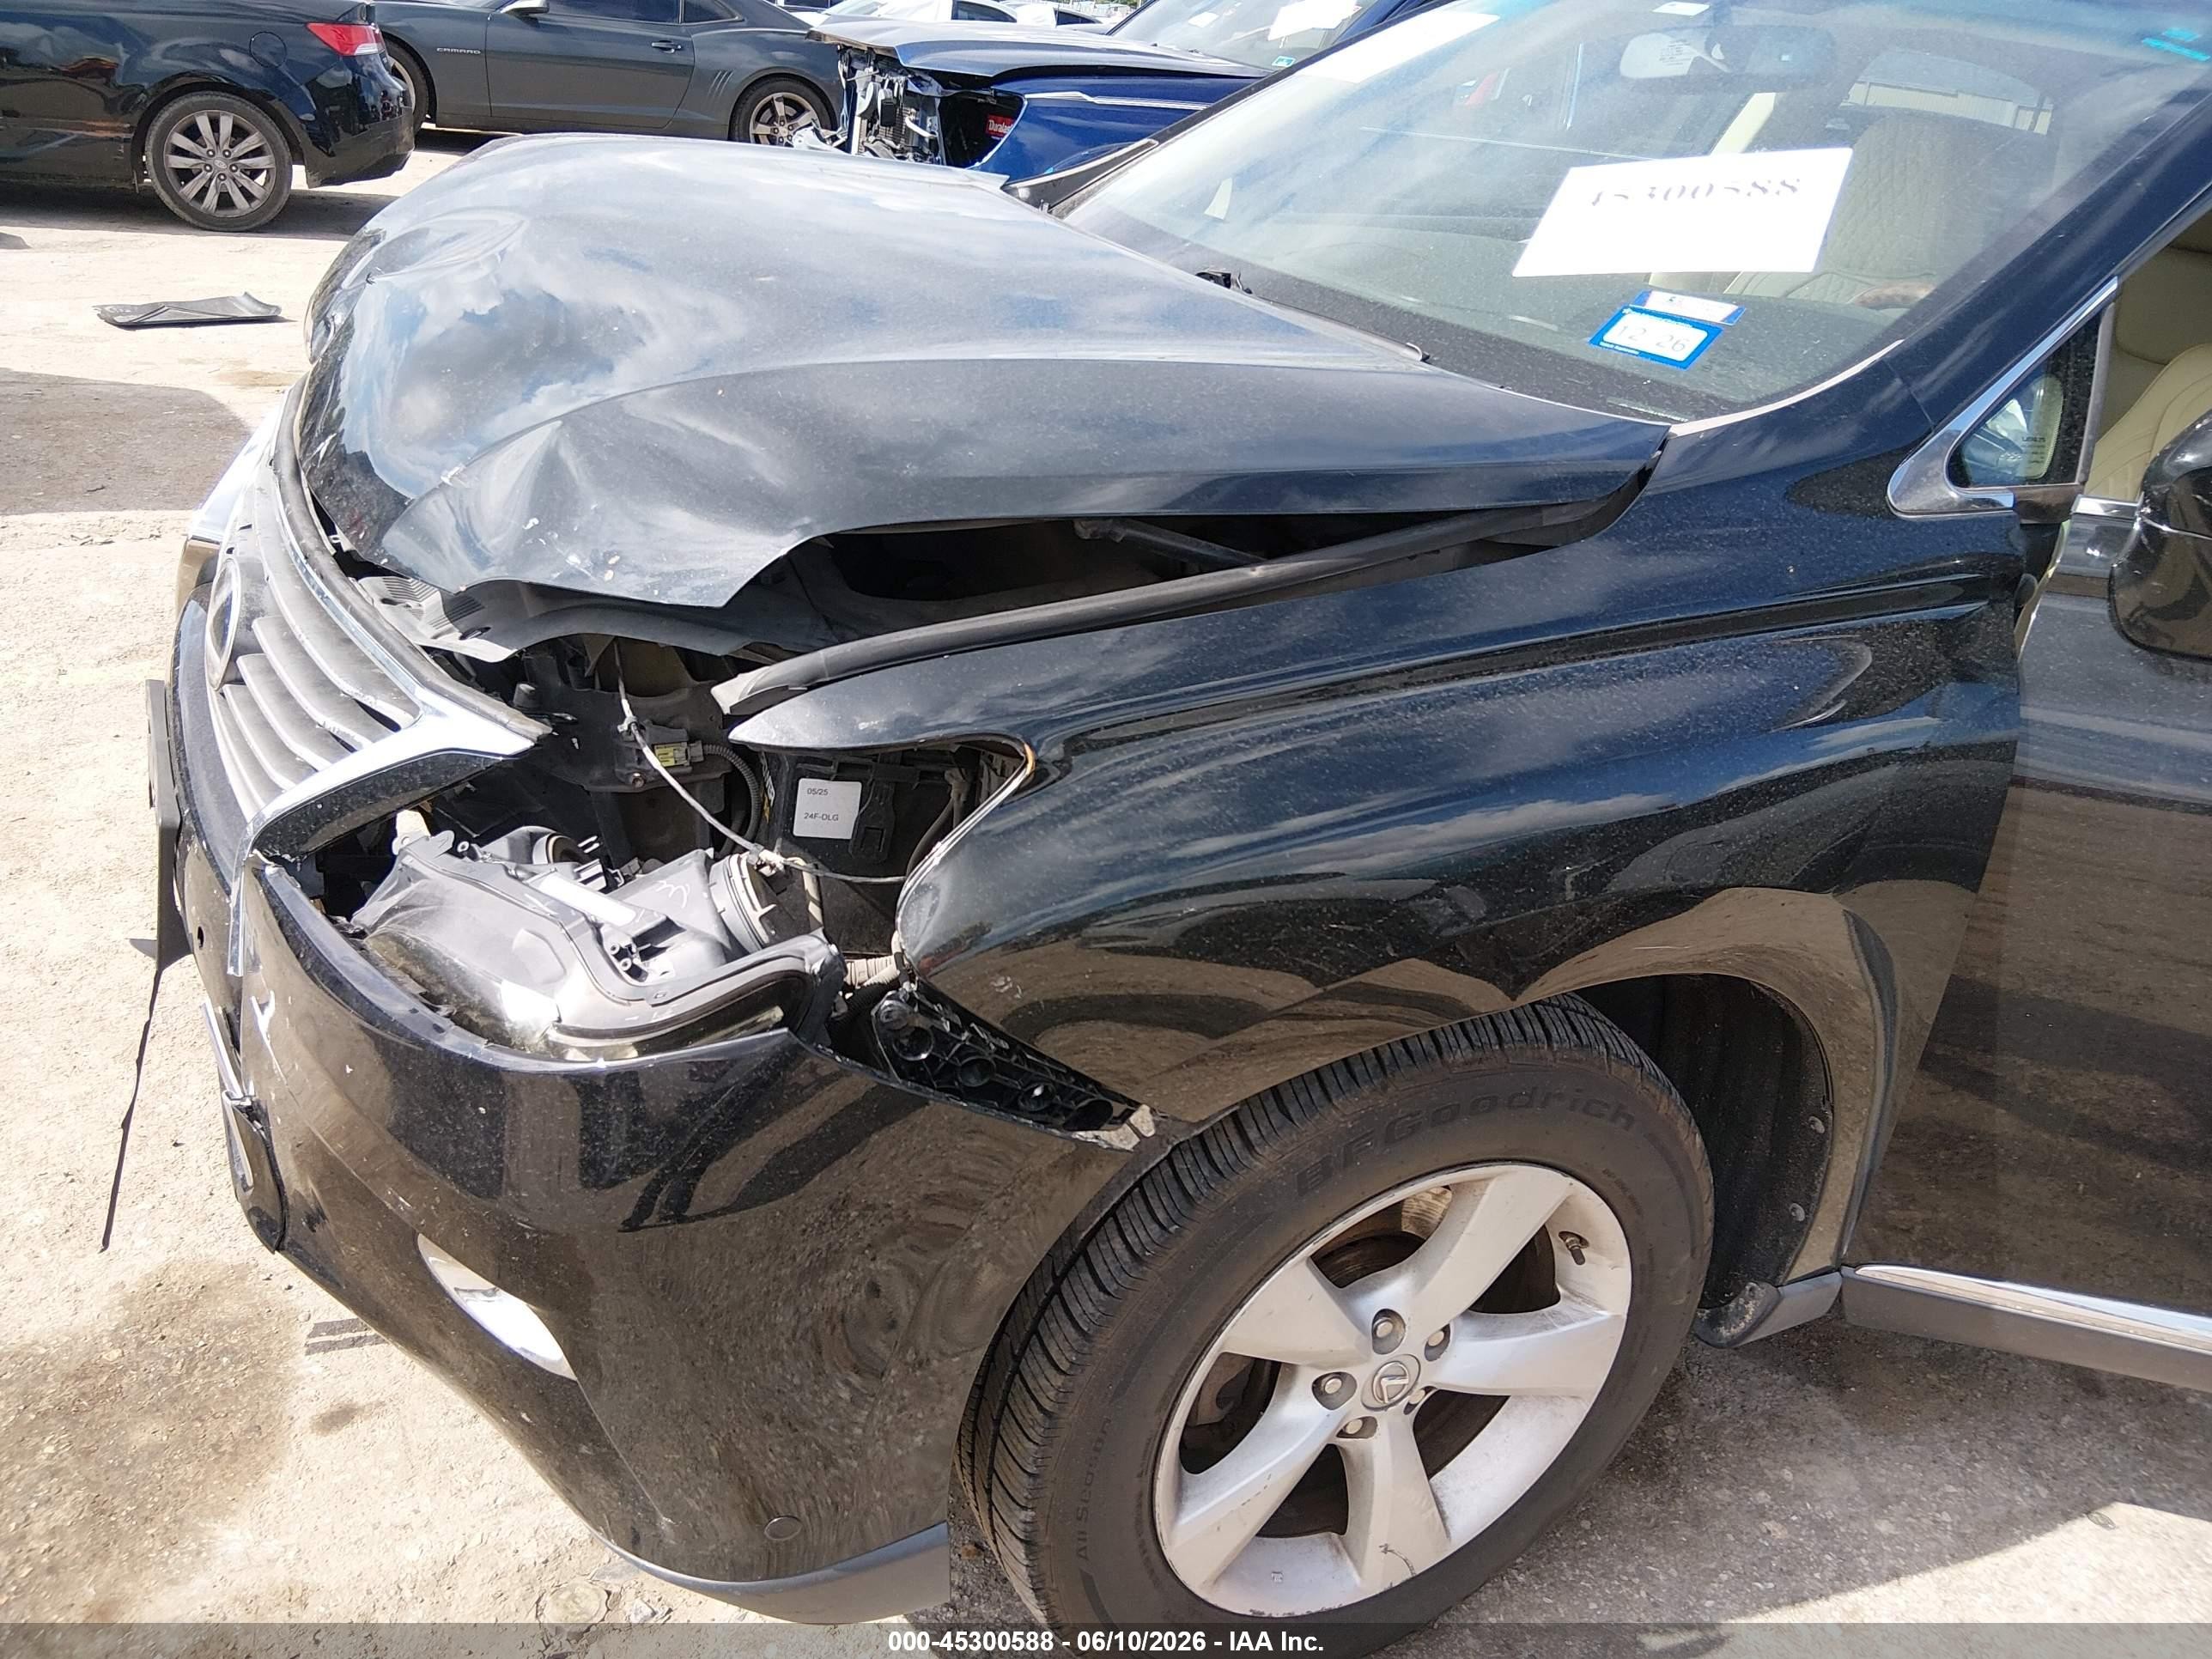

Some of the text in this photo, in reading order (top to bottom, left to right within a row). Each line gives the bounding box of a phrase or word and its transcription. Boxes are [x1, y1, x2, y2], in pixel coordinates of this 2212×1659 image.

[806, 787, 830, 796] 05/25
[803, 811, 840, 822] 24F-DLG
[1296, 1085, 1637, 1197] BFGoodrich
